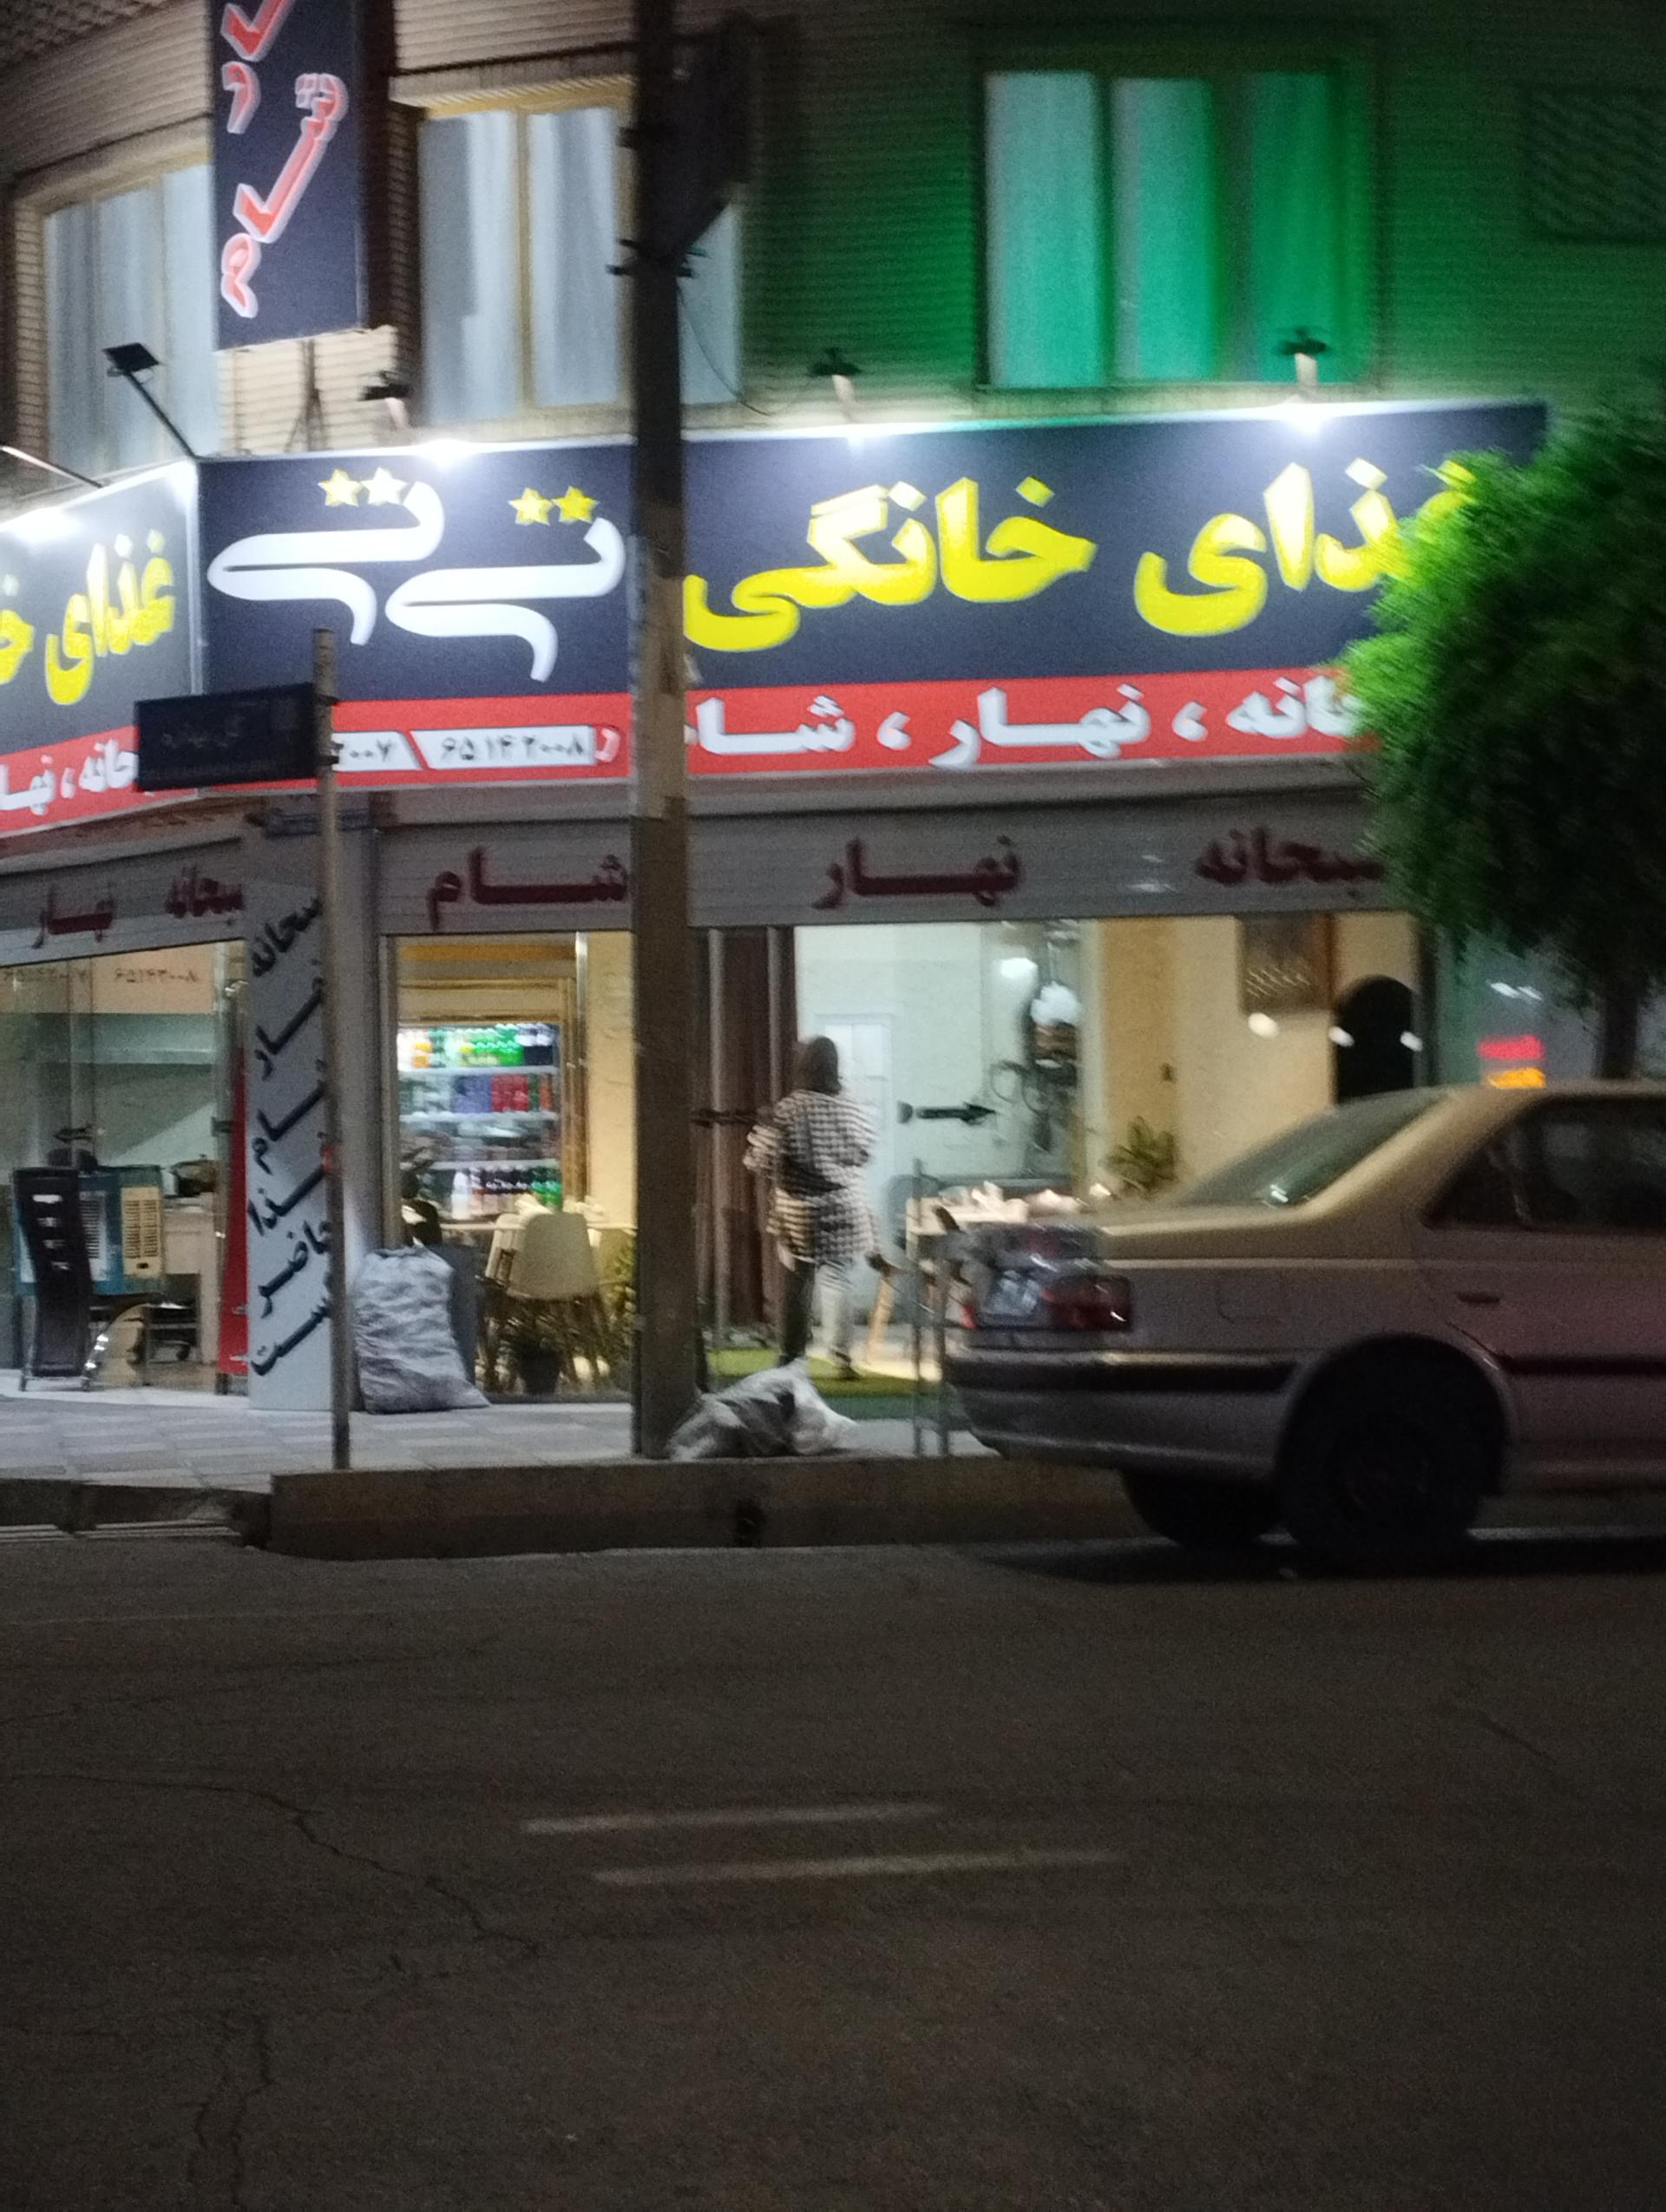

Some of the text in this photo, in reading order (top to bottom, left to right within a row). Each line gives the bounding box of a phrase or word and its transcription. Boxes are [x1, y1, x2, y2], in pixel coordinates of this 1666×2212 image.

[221, 73, 348, 318] شام
[683, 475, 1099, 652] خانگی
[46, 530, 176, 704] غذای
[684, 694, 856, 754] شا
[928, 682, 1152, 770] نهار
[1225, 677, 1371, 739] حانه
[0, 753, 56, 816] نها
[79, 738, 140, 792] حانه
[426, 846, 628, 930] شام
[810, 834, 1021, 907] نهار
